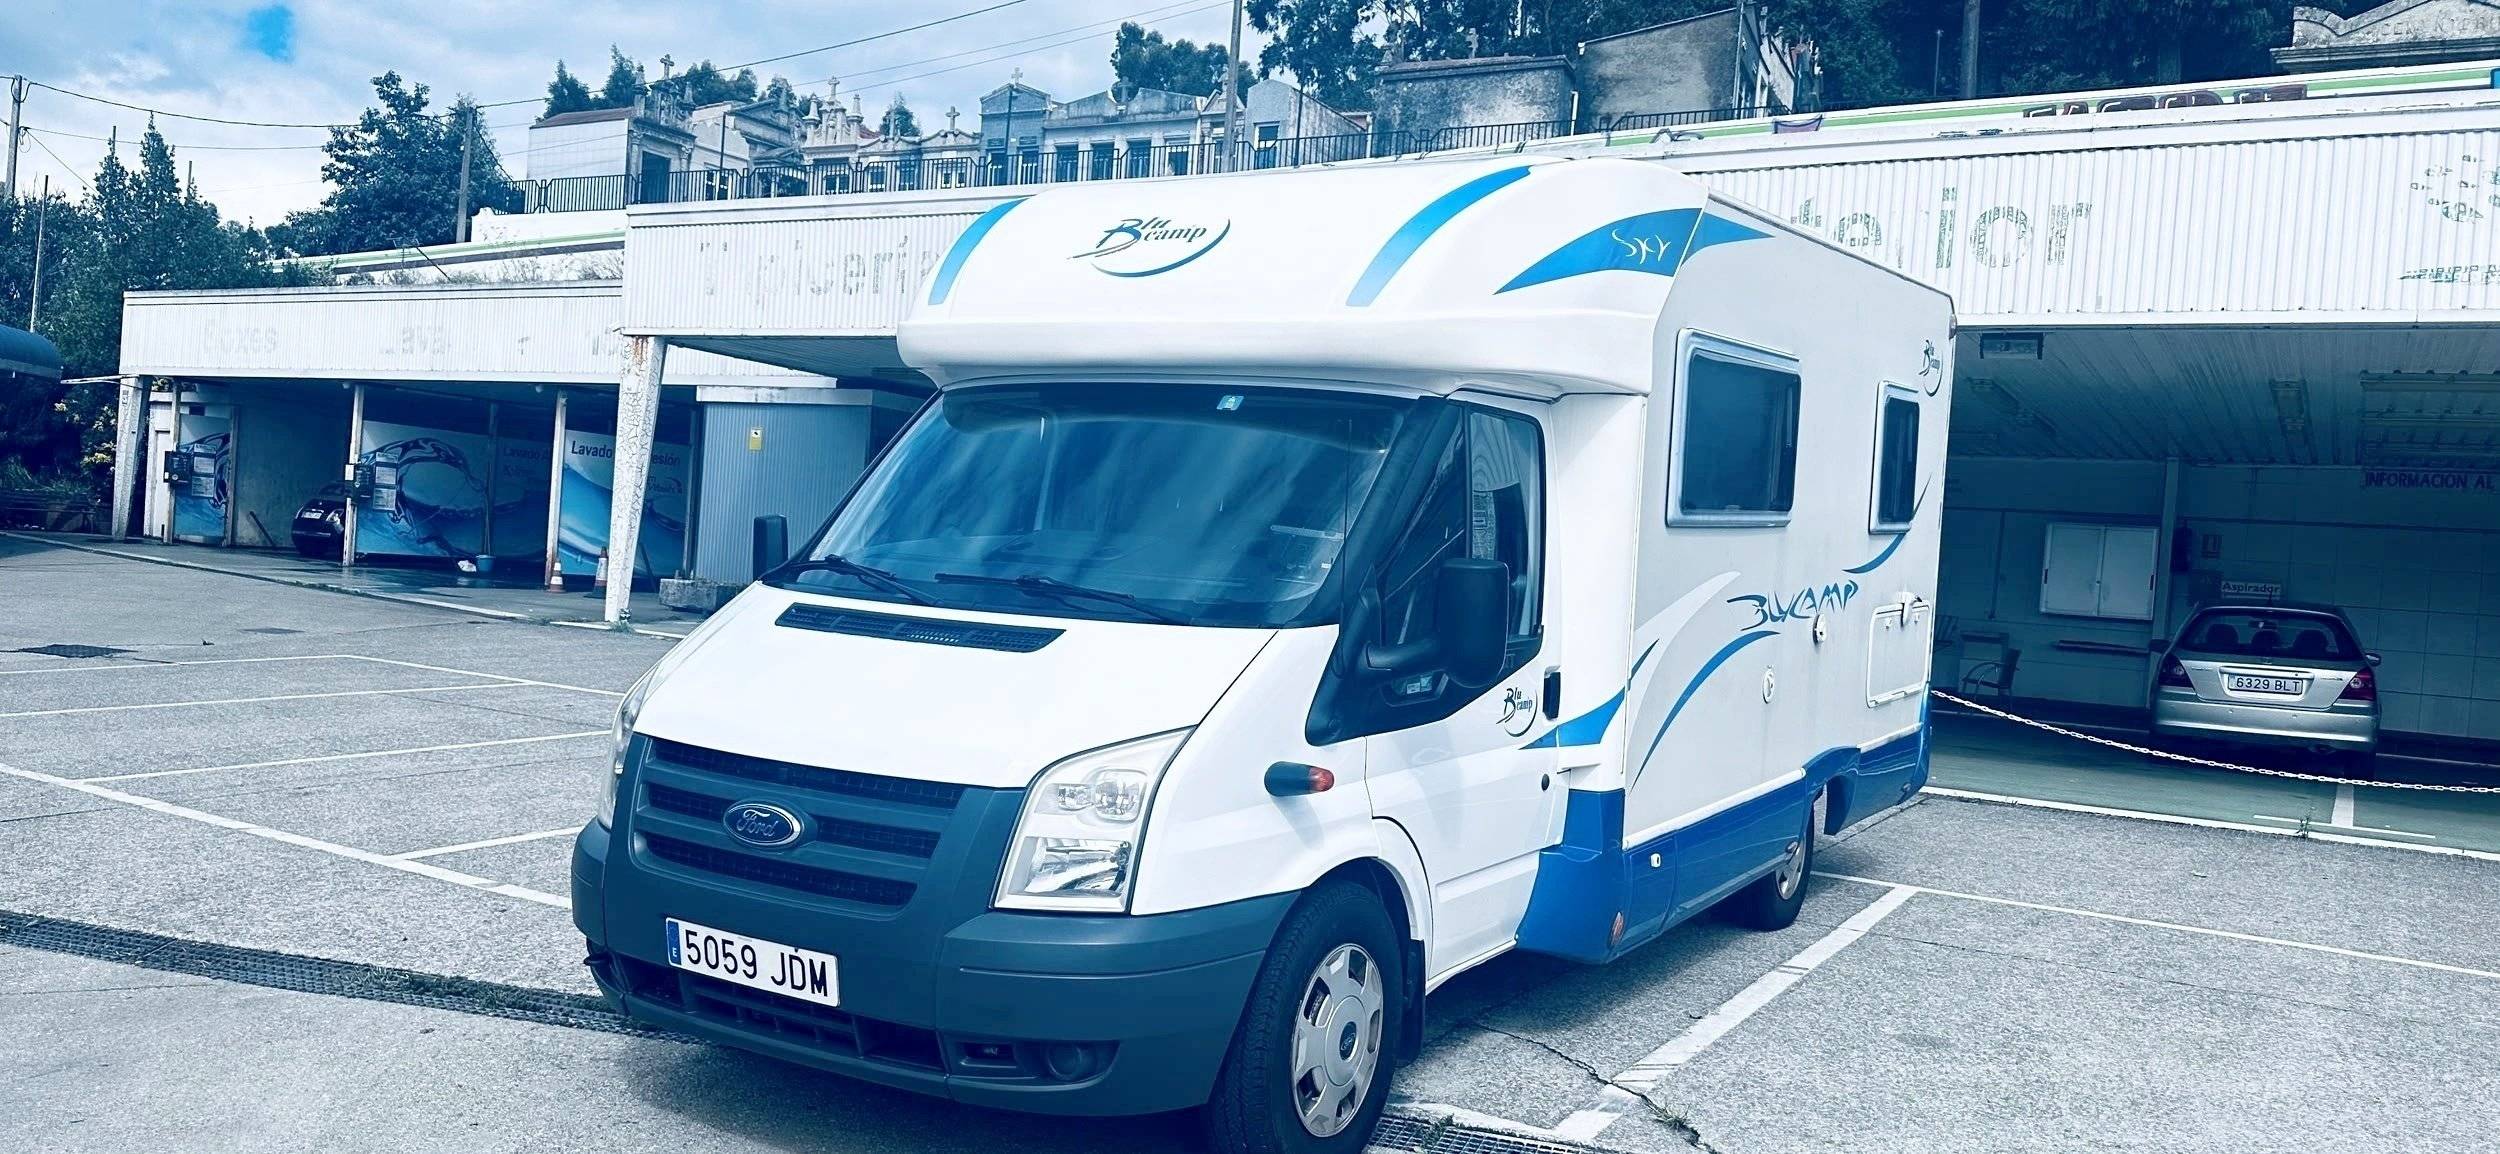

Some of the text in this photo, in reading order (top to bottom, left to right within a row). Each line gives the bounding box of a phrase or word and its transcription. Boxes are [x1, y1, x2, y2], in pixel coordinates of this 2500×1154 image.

[1067, 216, 1172, 258] Blu
[1143, 225, 1207, 243] camp
[1611, 227, 1672, 264] SKY
[571, 440, 613, 459] Lavado
[650, 452, 681, 467] esión
[2223, 582, 2281, 595] Aspirador
[2236, 677, 2300, 692] 6329 BLT
[1496, 687, 1522, 723] Blu
[736, 809, 779, 837] Ford
[672, 947, 678, 958] E
[685, 929, 828, 997] 5059 JDM
